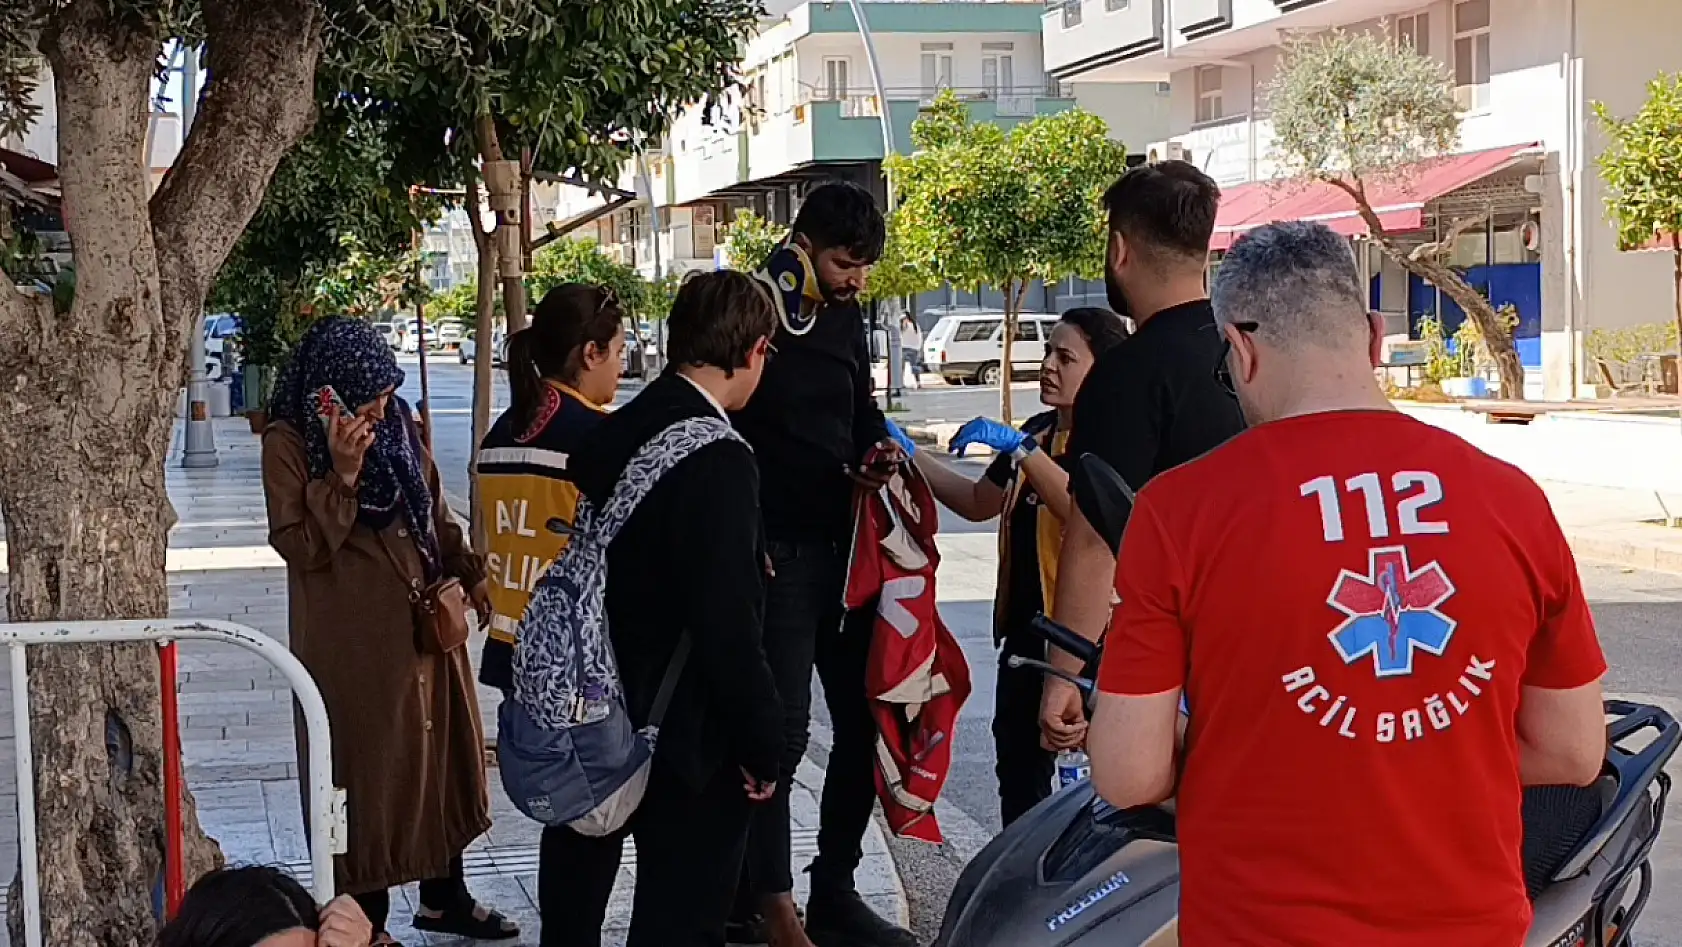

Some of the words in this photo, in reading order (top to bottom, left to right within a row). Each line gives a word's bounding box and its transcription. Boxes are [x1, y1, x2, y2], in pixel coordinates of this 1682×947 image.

[1300, 471, 1449, 541] 112
[1282, 666, 1357, 738] ACİL
[1376, 655, 1495, 742] SAĞLIK
[1046, 871, 1130, 930] FREEDOM
